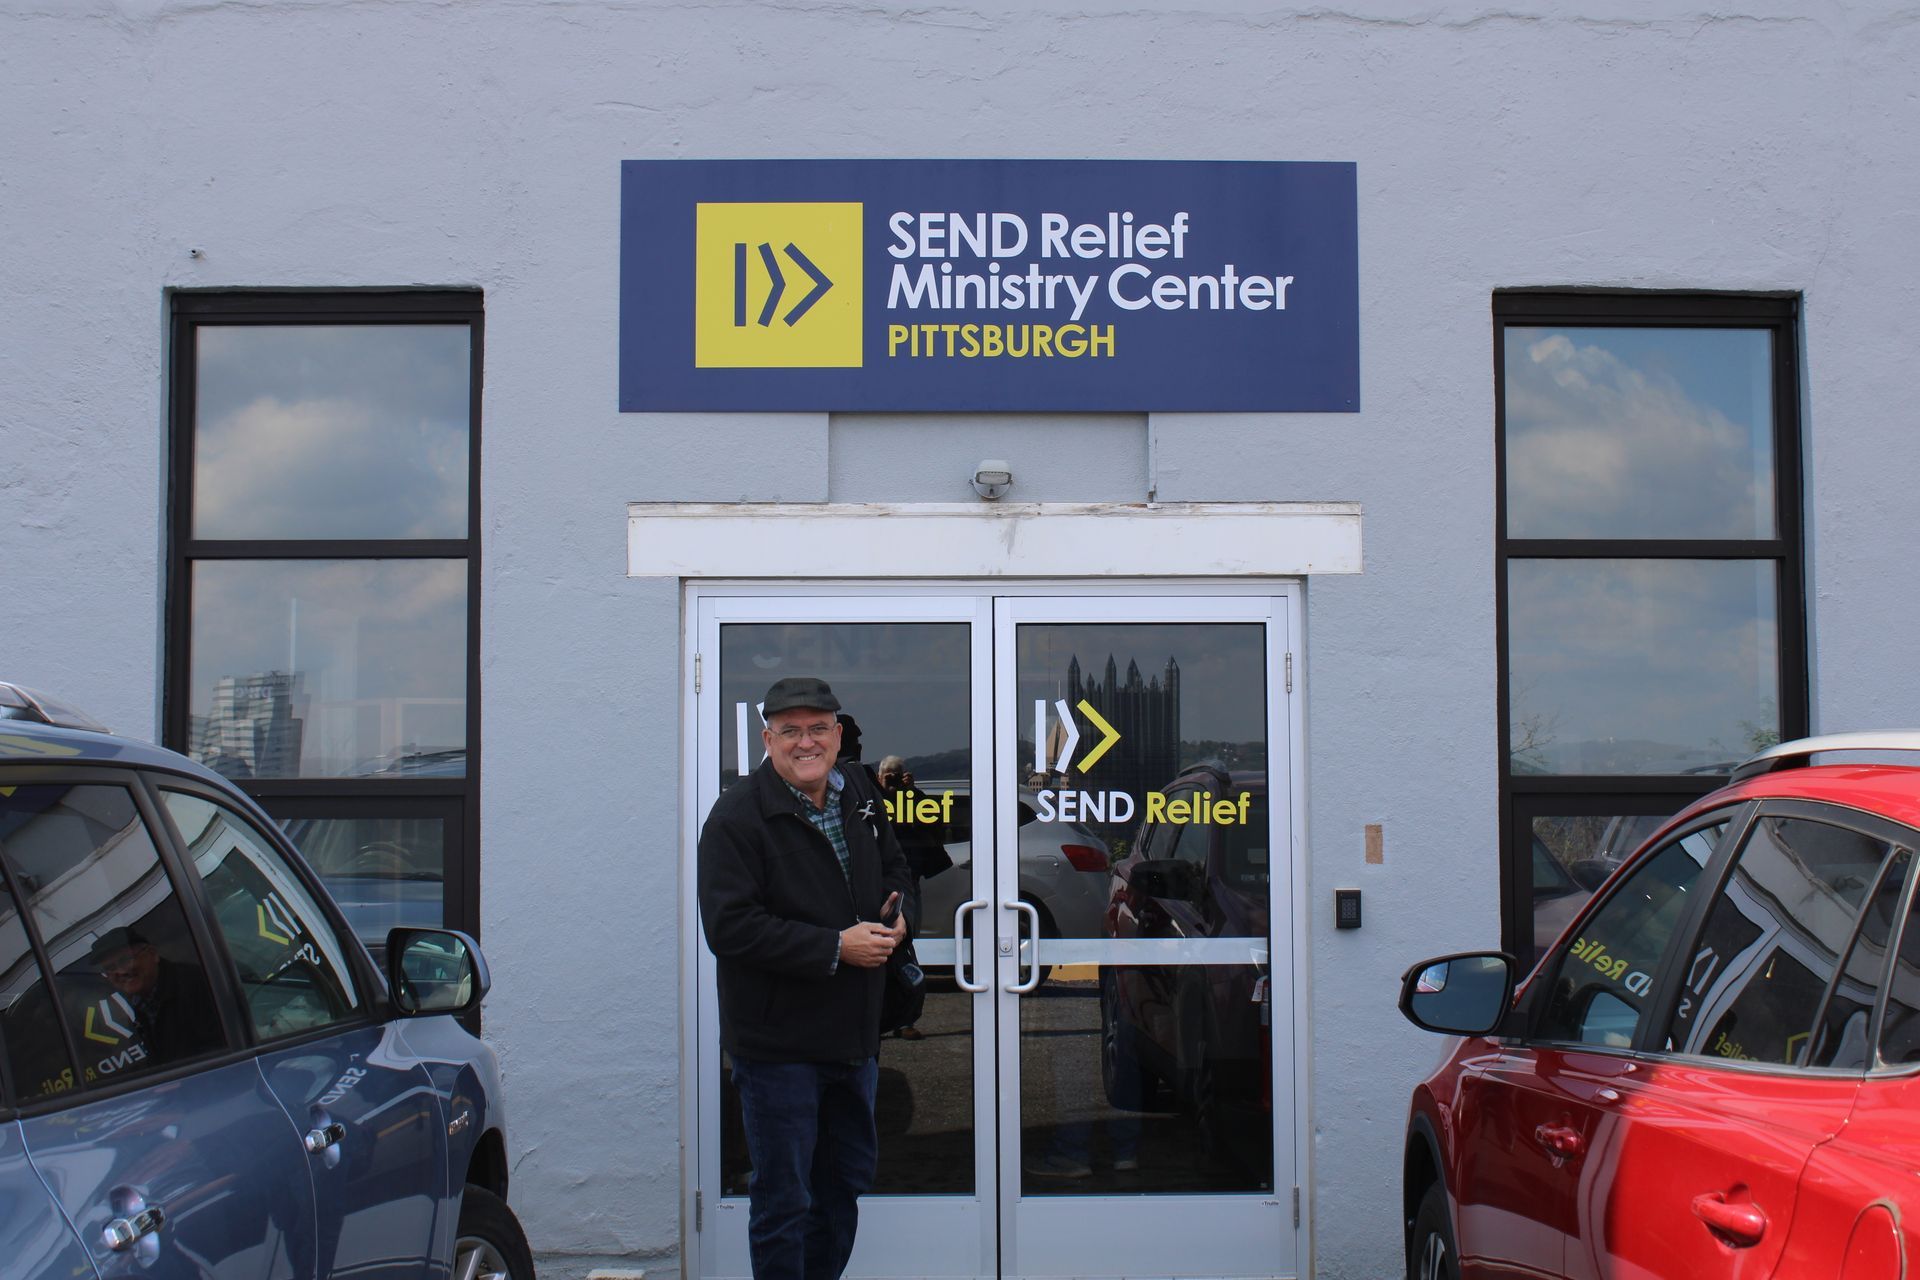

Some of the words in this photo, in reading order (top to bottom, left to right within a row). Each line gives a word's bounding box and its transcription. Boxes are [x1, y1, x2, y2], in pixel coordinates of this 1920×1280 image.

[887, 211, 1029, 259] SEND
[1041, 211, 1189, 259] Relief
[887, 262, 1099, 321] Ministry
[1108, 263, 1294, 311] Center
[888, 323, 1115, 358] PITTSBURGH
[883, 790, 954, 824] lief
[1036, 789, 1135, 823] SEND
[1146, 791, 1251, 825] Relief
